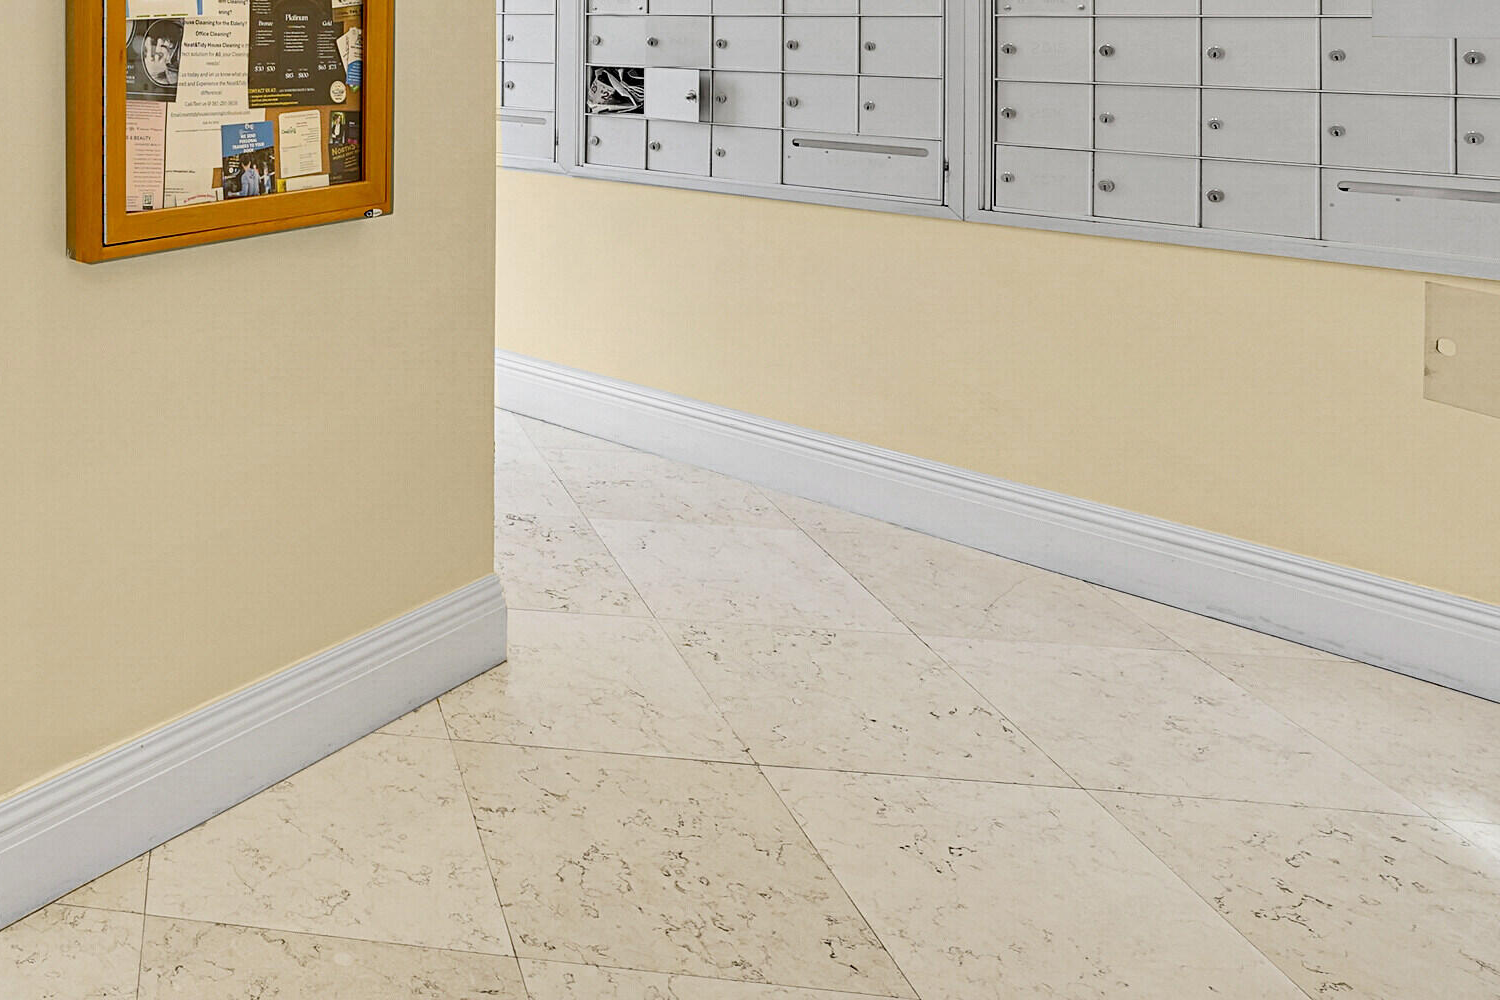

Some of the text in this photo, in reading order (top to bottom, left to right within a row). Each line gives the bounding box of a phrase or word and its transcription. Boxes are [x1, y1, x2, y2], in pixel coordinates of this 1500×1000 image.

[285, 13, 309, 22] Platinum
[195, 19, 215, 27] Cleaning
[209, 30, 232, 38] Cleaning?
[184, 41, 207, 49] Neat&Tidy
